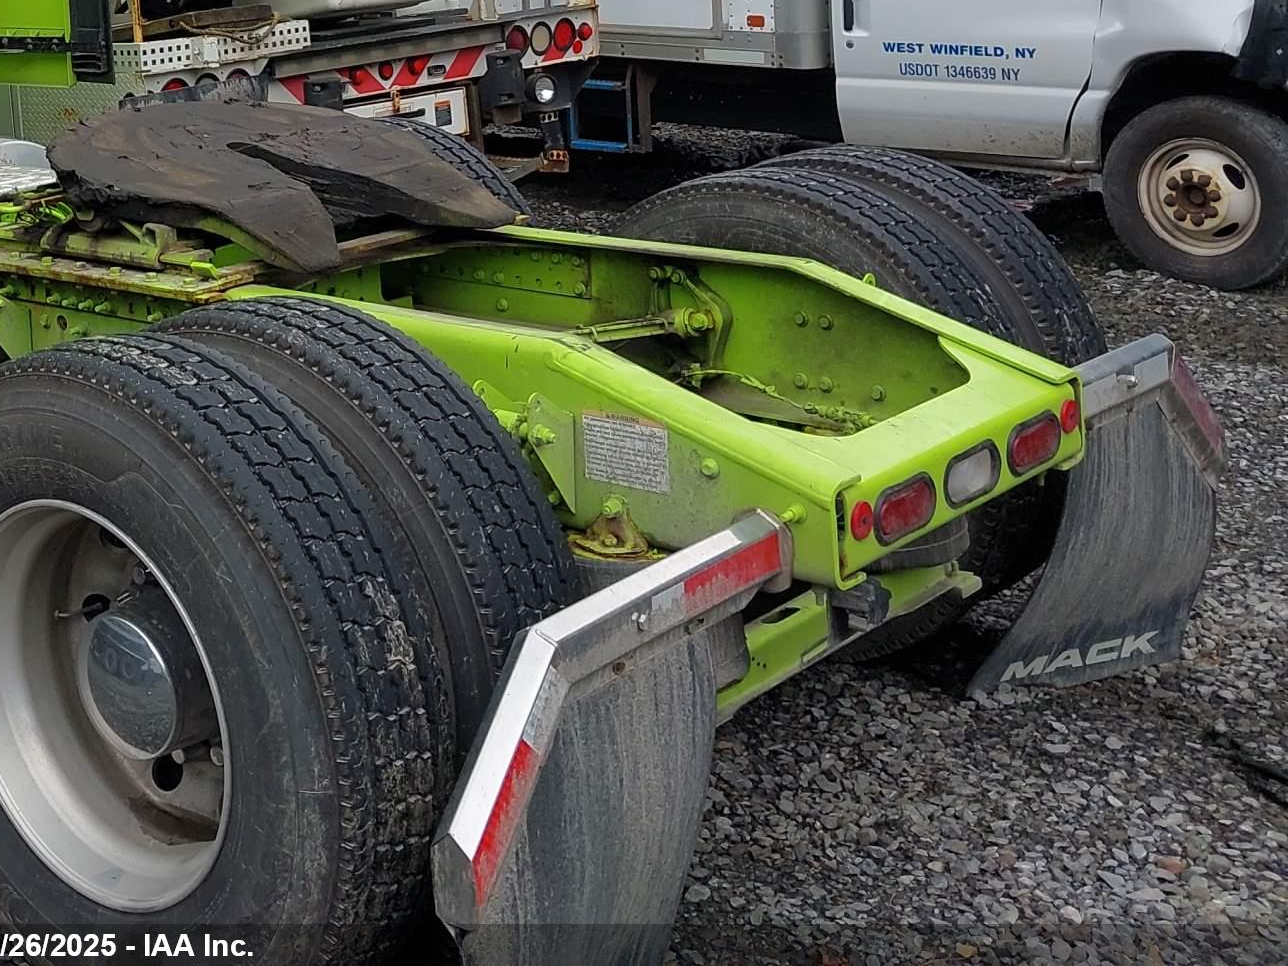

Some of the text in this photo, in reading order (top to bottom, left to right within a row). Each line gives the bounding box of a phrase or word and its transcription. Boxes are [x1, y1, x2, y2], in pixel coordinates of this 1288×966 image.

[883, 41, 1037, 60] WEST WINFIELD, NY
[899, 62, 1021, 81] USDOT 1346639 NY
[999, 630, 1160, 683] MACK
